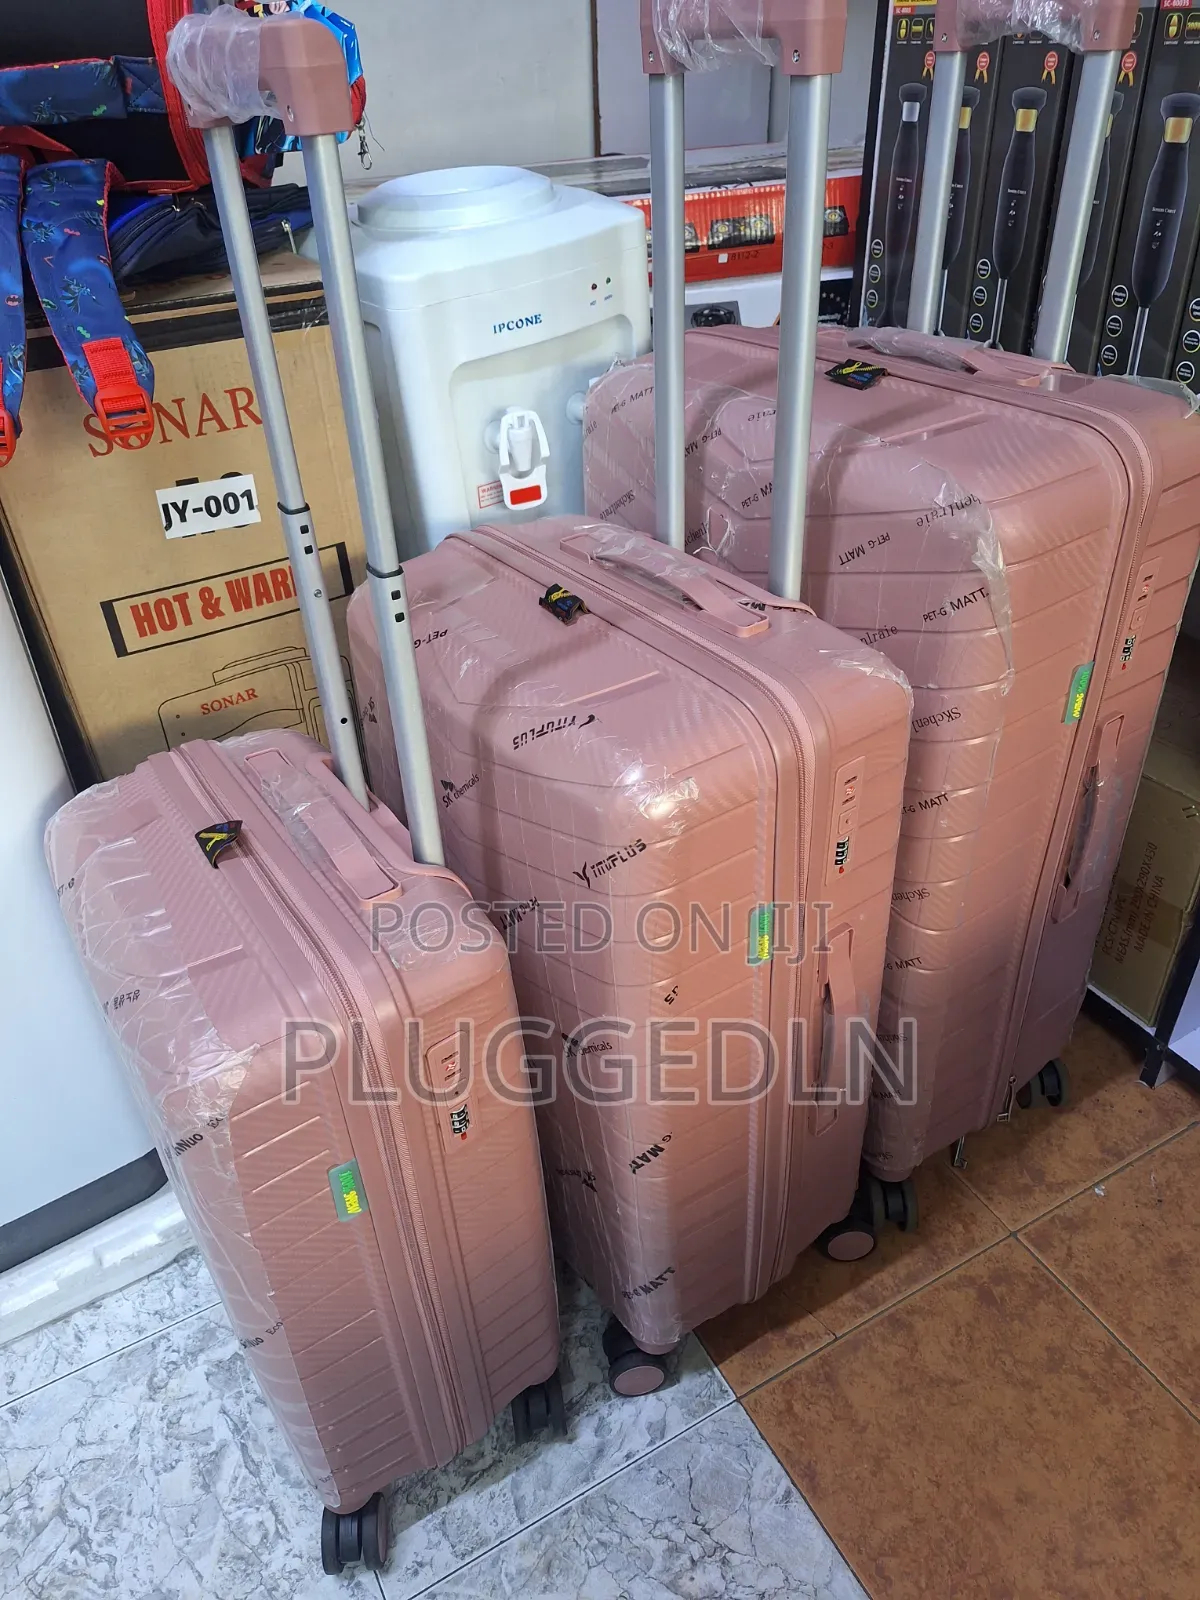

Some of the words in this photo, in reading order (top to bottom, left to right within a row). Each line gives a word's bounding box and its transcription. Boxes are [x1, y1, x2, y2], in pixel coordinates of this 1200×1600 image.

[493, 314, 542, 334] IPCONE
[629, 386, 655, 402] MATT
[161, 489, 258, 532] JY-001
[741, 491, 760, 510] PET-G
[868, 532, 891, 550] PET-G
[838, 543, 866, 566] MATT
[130, 592, 193, 638] HOT
[199, 586, 225, 620] &
[226, 566, 297, 613] WAR
[923, 607, 947, 623] PET-G
[414, 629, 448, 649] PET-G
[200, 688, 259, 715] SONAR
[442, 791, 454, 808] SK
[453, 773, 480, 800] chemicals
[918, 793, 949, 811] MATT
[1148, 875, 1166, 909] CHINA
[895, 956, 923, 970] MATT
